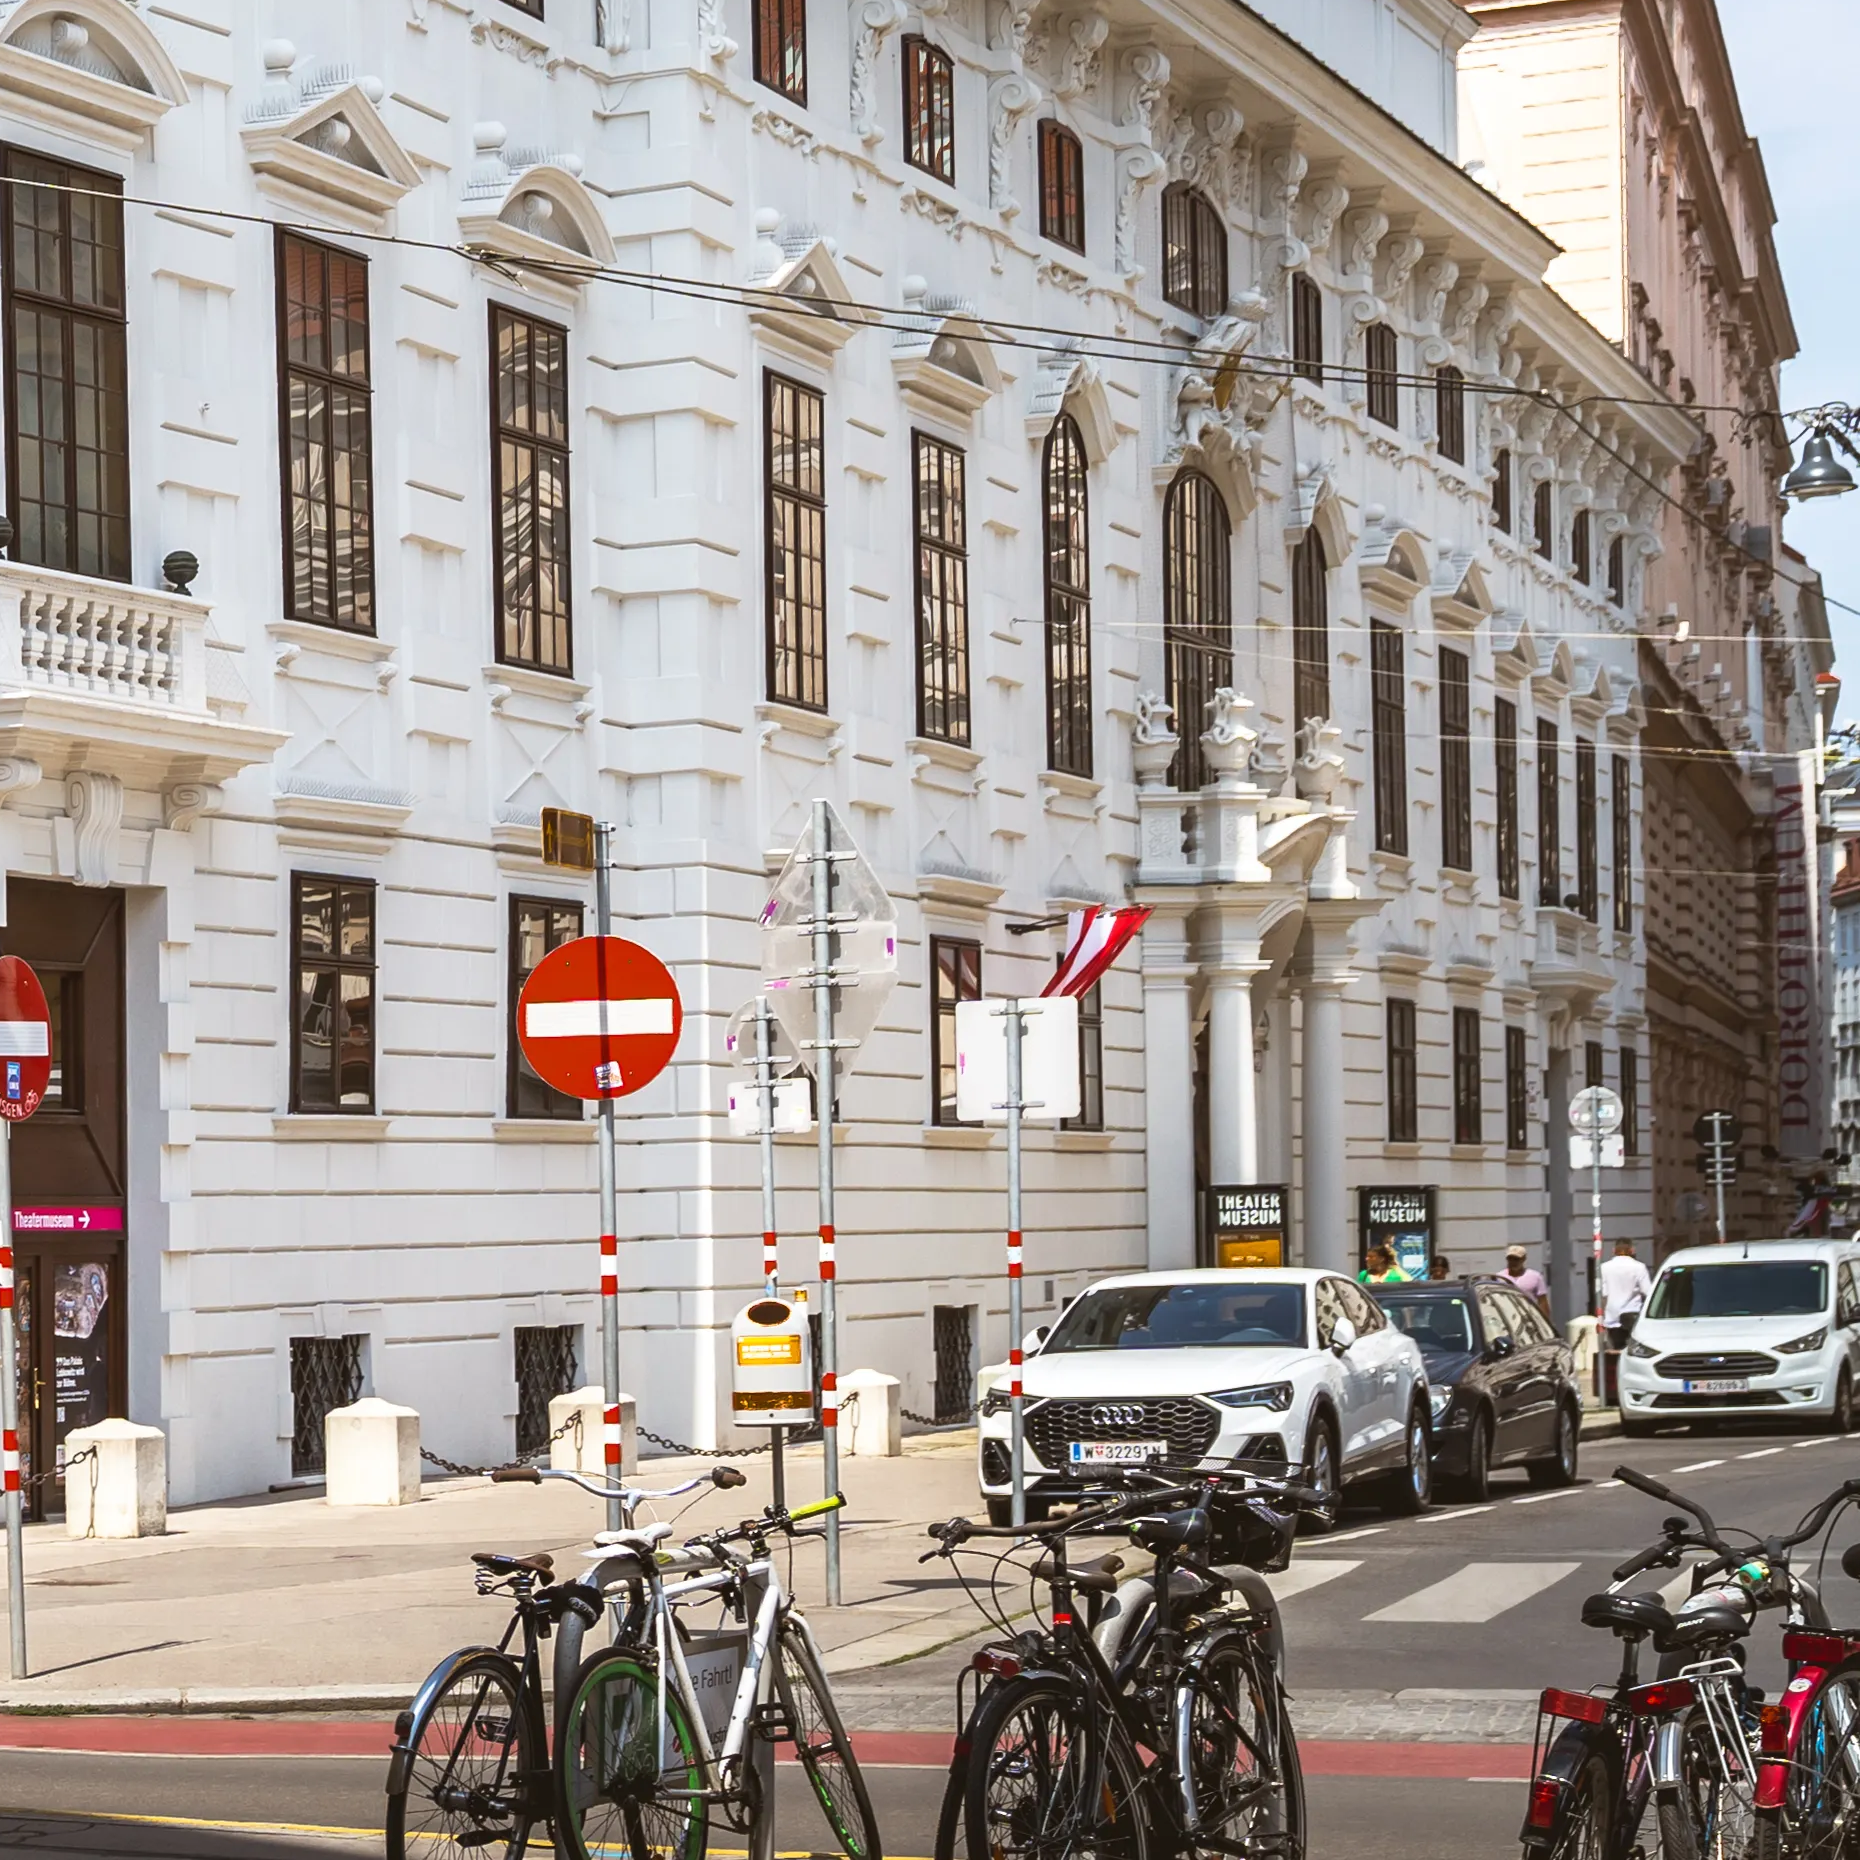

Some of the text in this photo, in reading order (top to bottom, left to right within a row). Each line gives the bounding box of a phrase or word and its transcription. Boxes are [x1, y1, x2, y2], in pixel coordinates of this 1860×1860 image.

[1217, 1193, 1281, 1211] THEATER
[14, 1211, 75, 1228] Theatermuseum
[1370, 1208, 1427, 1223] MUSEUM
[1084, 1446, 1094, 1459] W
[1105, 1445, 1149, 1459] 32291
[1676, 1616, 1705, 1630] GIANT
[701, 1664, 733, 1689] Fahrt!
